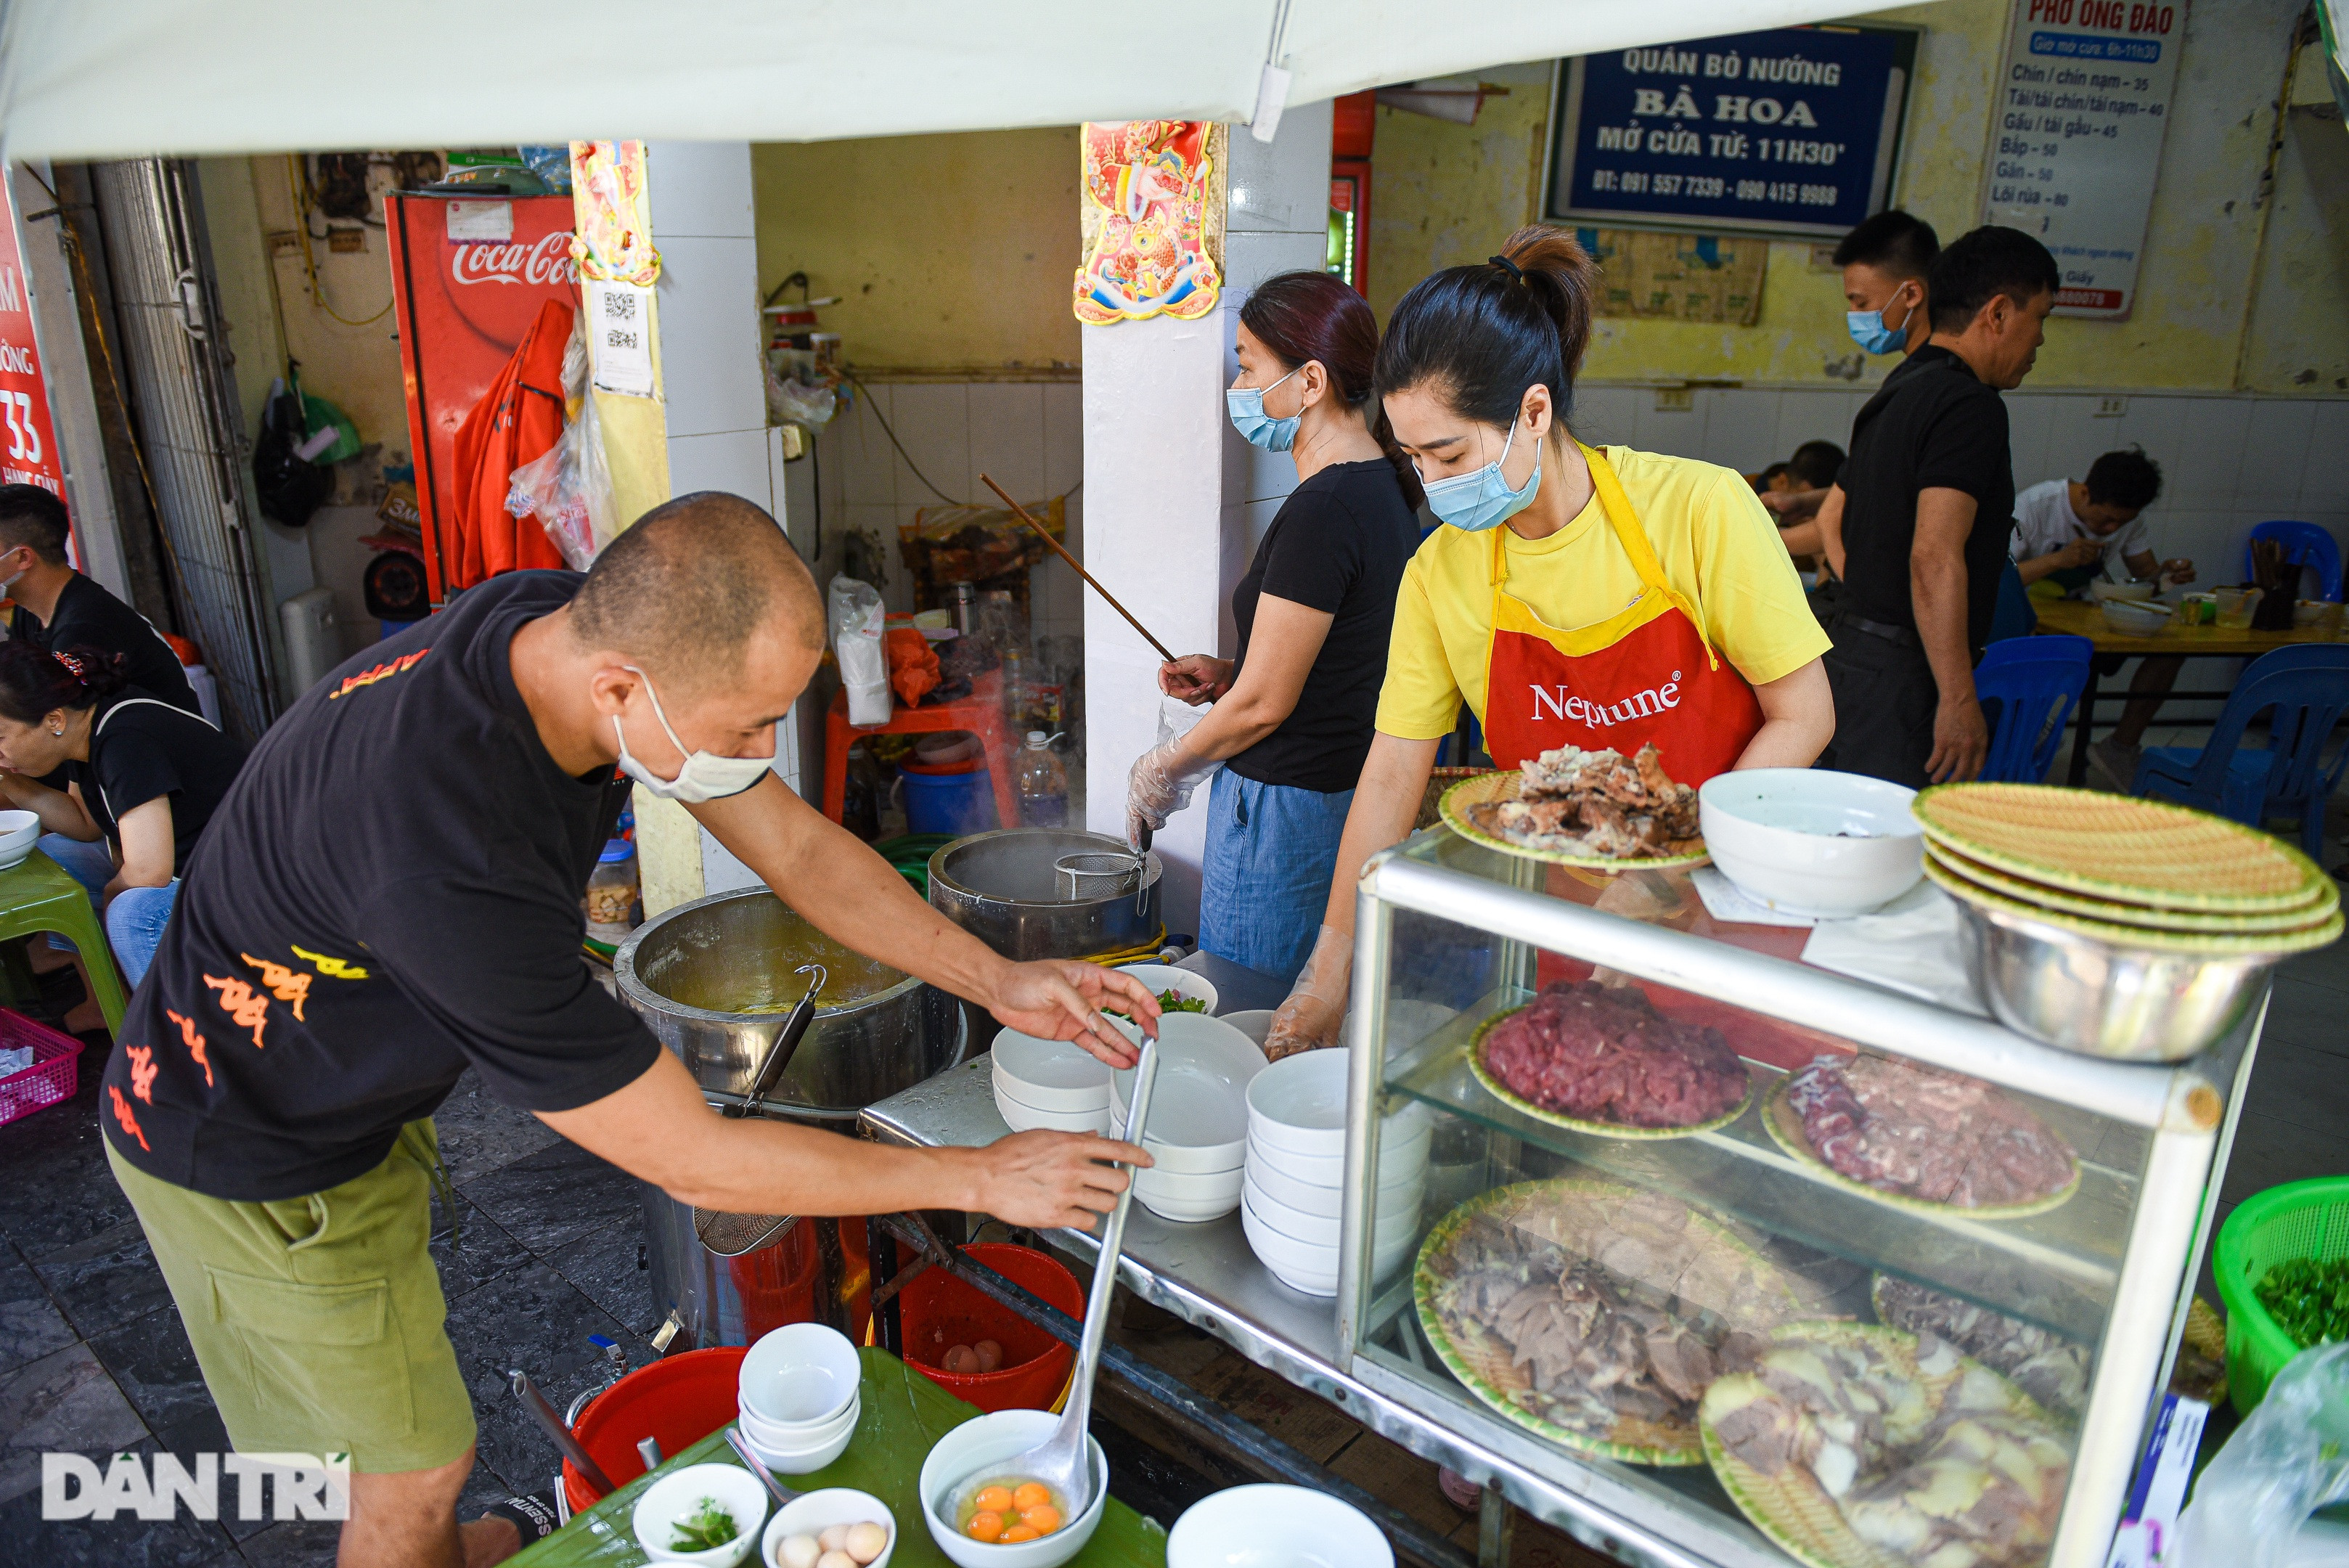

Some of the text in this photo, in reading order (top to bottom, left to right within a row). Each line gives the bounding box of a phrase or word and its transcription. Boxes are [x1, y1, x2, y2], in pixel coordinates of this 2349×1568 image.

[1622, 46, 1842, 87] QUÁN BÒ NƯỚNG
[1633, 84, 1818, 128] BÀ HOA
[1596, 120, 1645, 153] MỞ
[1646, 122, 1702, 157] CỬA
[1529, 682, 1681, 730] Neptune
